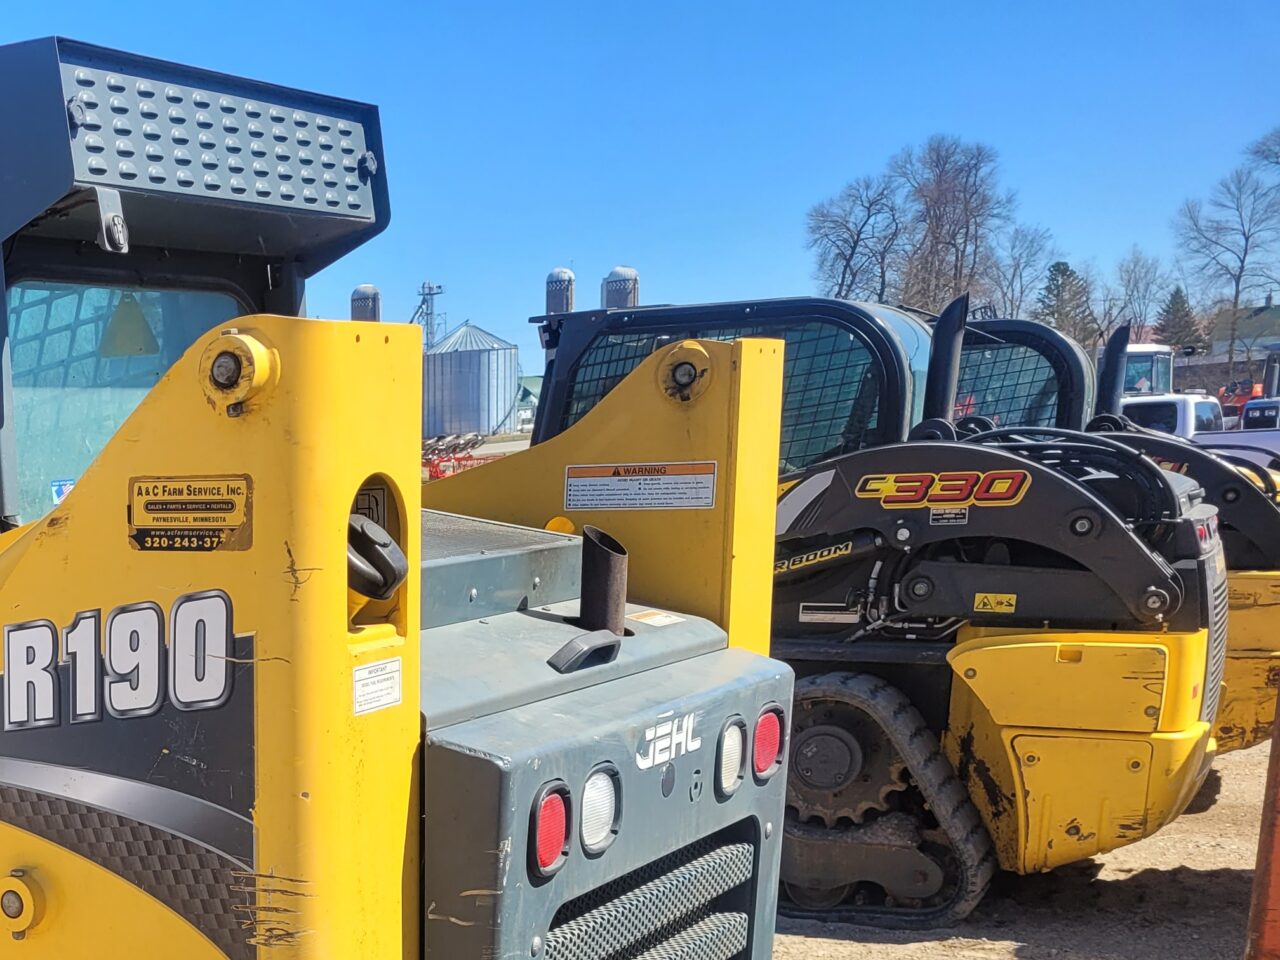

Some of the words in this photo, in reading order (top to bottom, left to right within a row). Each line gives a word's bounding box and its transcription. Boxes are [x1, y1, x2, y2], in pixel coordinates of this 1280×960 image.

[623, 466, 667, 475] WARNING
[137, 486, 143, 496] A
[145, 487, 150, 496] &
[152, 485, 159, 496] C
[162, 485, 184, 496] FARM
[855, 470, 1032, 509] C330
[790, 541, 853, 569] BOOM
[3, 588, 234, 732] R190
